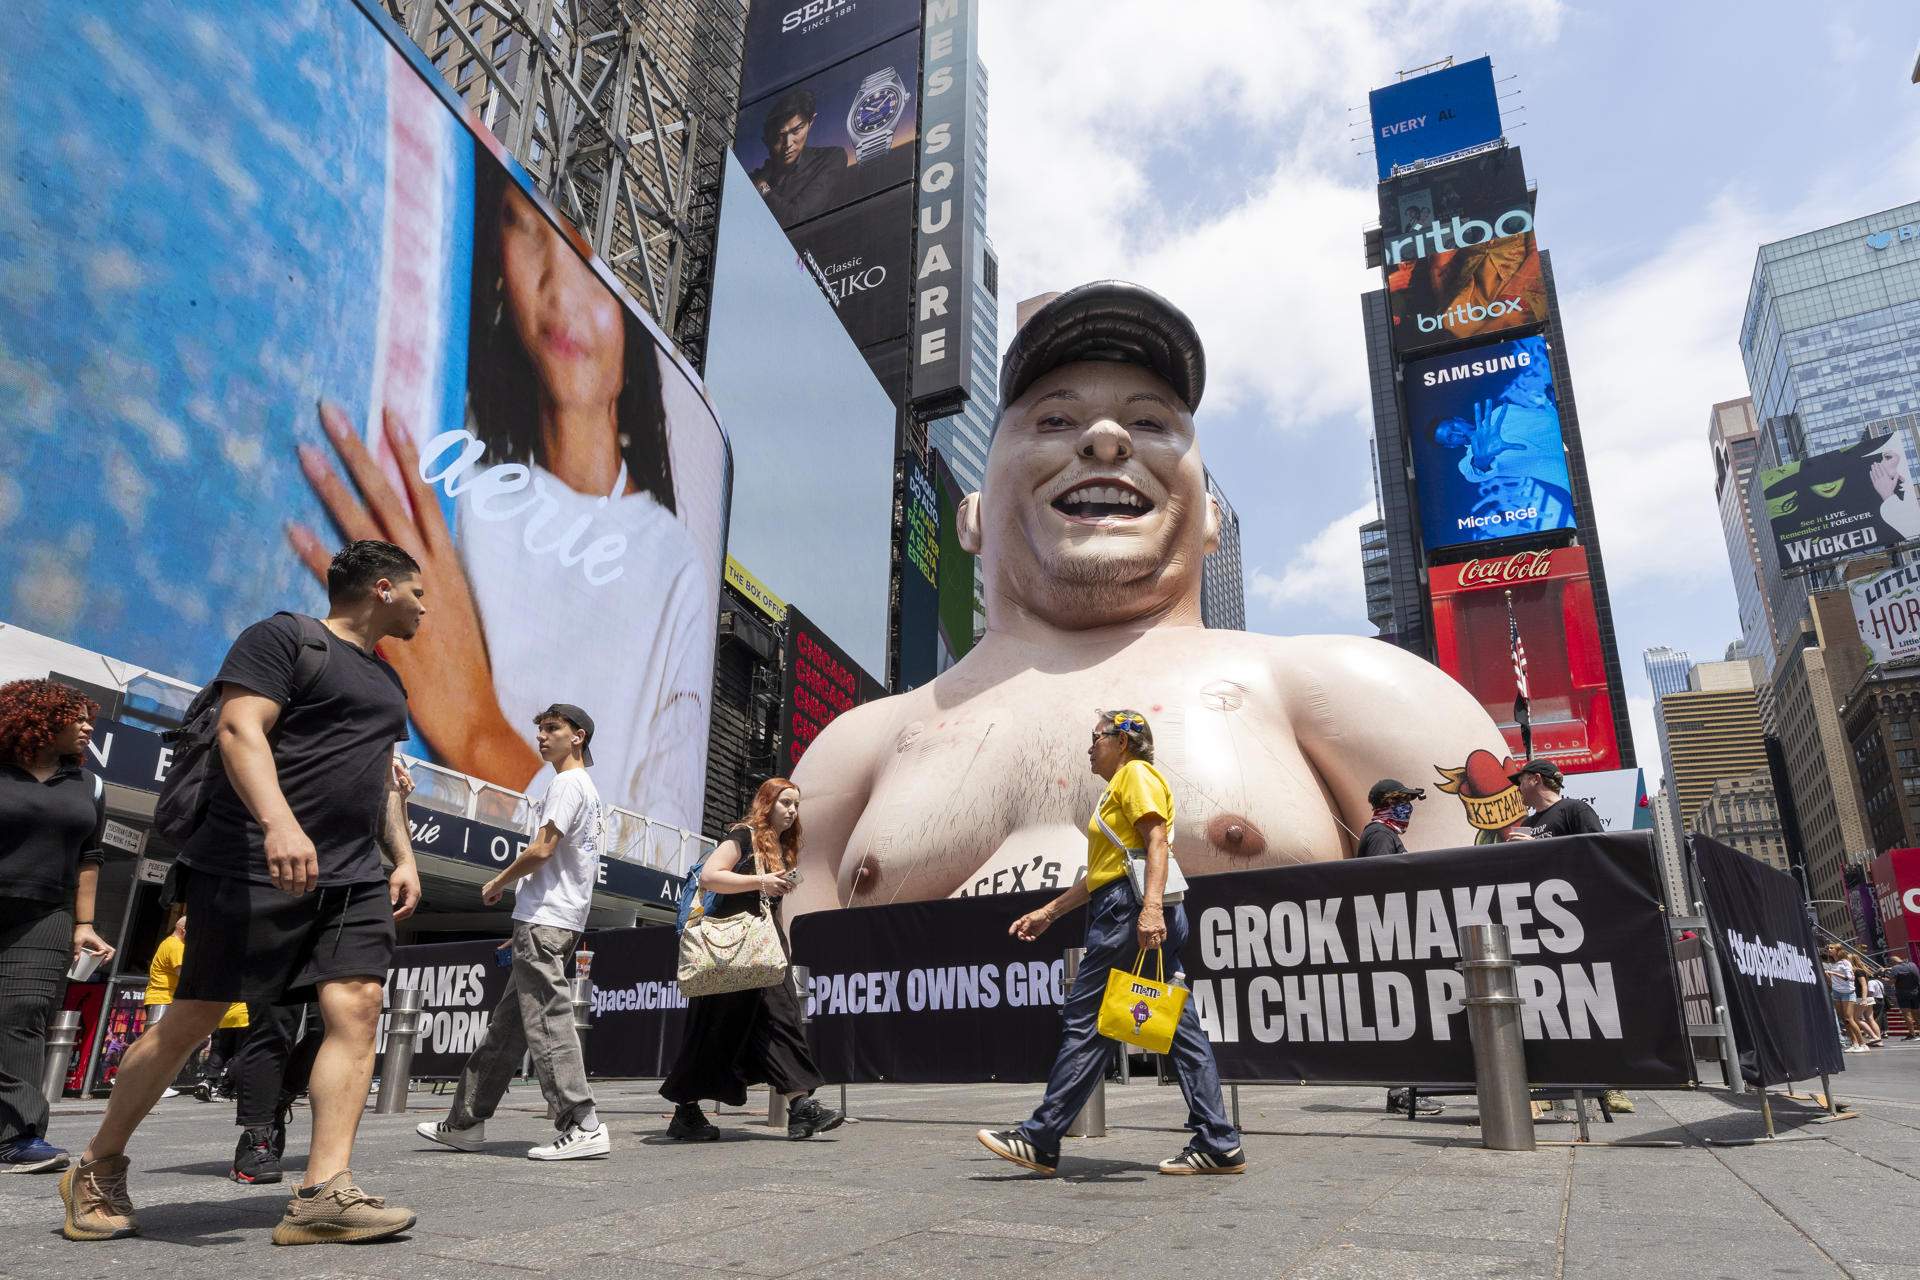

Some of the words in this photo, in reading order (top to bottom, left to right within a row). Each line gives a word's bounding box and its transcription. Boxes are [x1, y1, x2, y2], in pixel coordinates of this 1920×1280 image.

[802, 16, 830, 34] SINCE
[835, 3, 857, 18] 1881
[1381, 115, 1426, 138] EVERY
[918, 122, 954, 365] SQUARE
[824, 257, 862, 276] Classic
[1417, 296, 1524, 333] britbox
[1423, 352, 1531, 387] SAMSUNG
[910, 476, 921, 499] DO
[915, 465, 937, 506] DAQUI
[419, 429, 628, 587] aerie
[919, 506, 936, 537] MAIS
[1457, 513, 1502, 530] Micro
[1504, 506, 1538, 523] RGB
[1800, 519, 1815, 528] See
[910, 529, 916, 545] A
[917, 537, 937, 572] SEXTA
[927, 532, 939, 559] VER
[1780, 525, 1821, 541] Remember
[729, 565, 744, 586] THE
[745, 580, 761, 600] BOX
[763, 595, 787, 621] OFFICE
[1865, 564, 1920, 606] LITTL
[797, 632, 855, 695] CHICAGO
[148, 863, 168, 872] PEDESTR
[1880, 890, 1903, 922] FIVE
[1199, 897, 1348, 971] GROK
[1353, 878, 1585, 963] MAKES
[906, 962, 1000, 1012] OWNS
[1005, 958, 1065, 1008] GRO
[1247, 968, 1417, 1043] CHILD
[1425, 961, 1623, 1041] PRN
